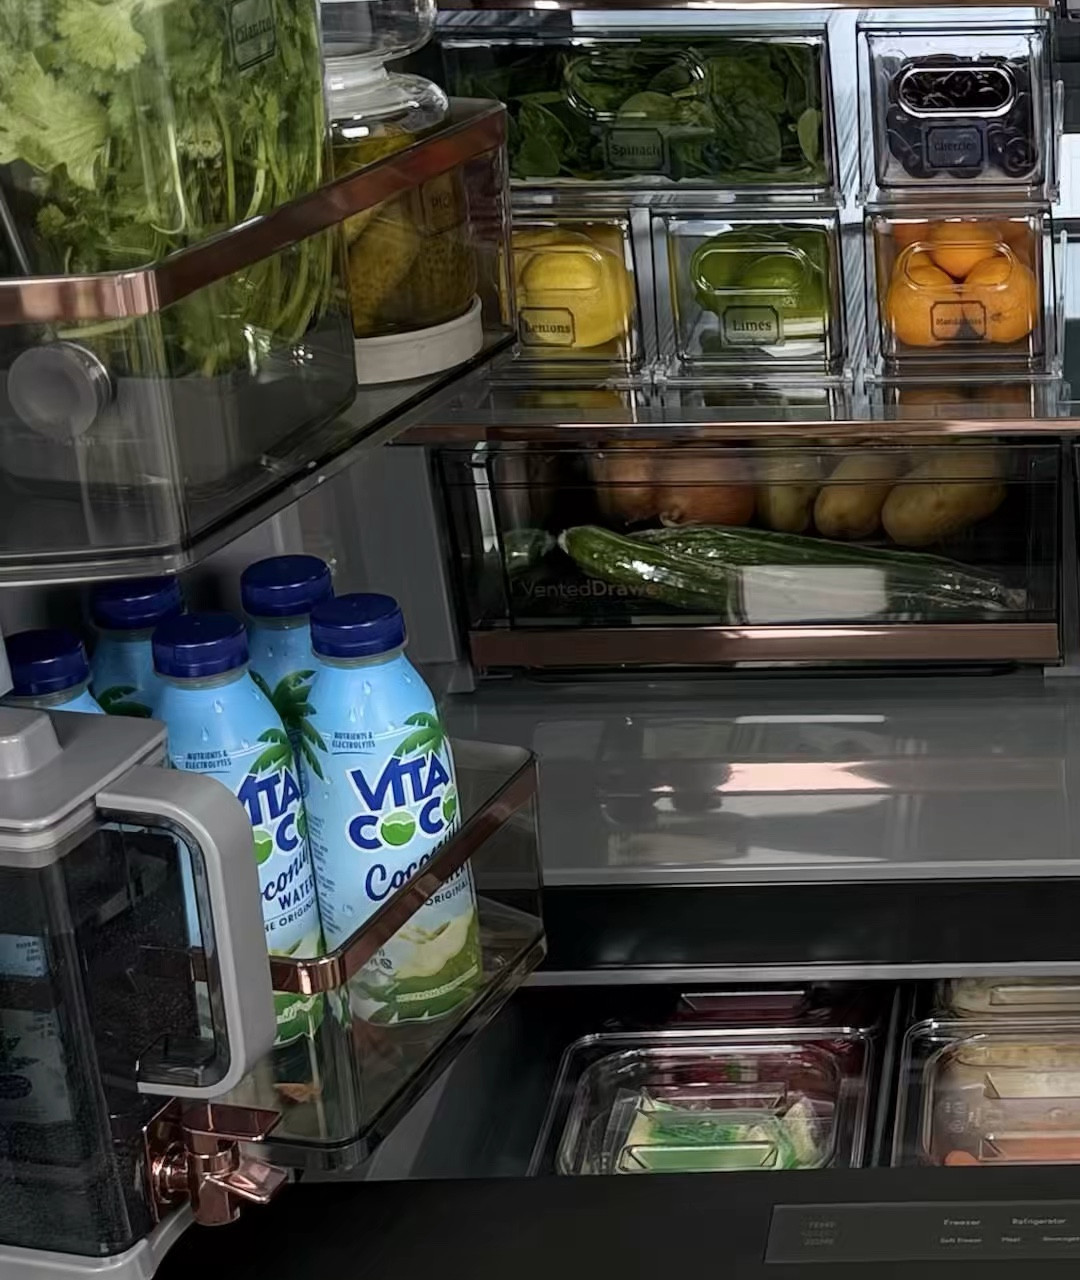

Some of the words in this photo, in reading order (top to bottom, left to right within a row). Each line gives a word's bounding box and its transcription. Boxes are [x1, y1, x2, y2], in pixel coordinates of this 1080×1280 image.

[611, 143, 661, 158] Spinach
[525, 321, 571, 334] Lemons
[733, 319, 772, 332] Limes
[331, 739, 376, 749] ELECTROLYTES
[185, 758, 232, 770] ELECTROLYTES
[350, 752, 451, 812] VITA
